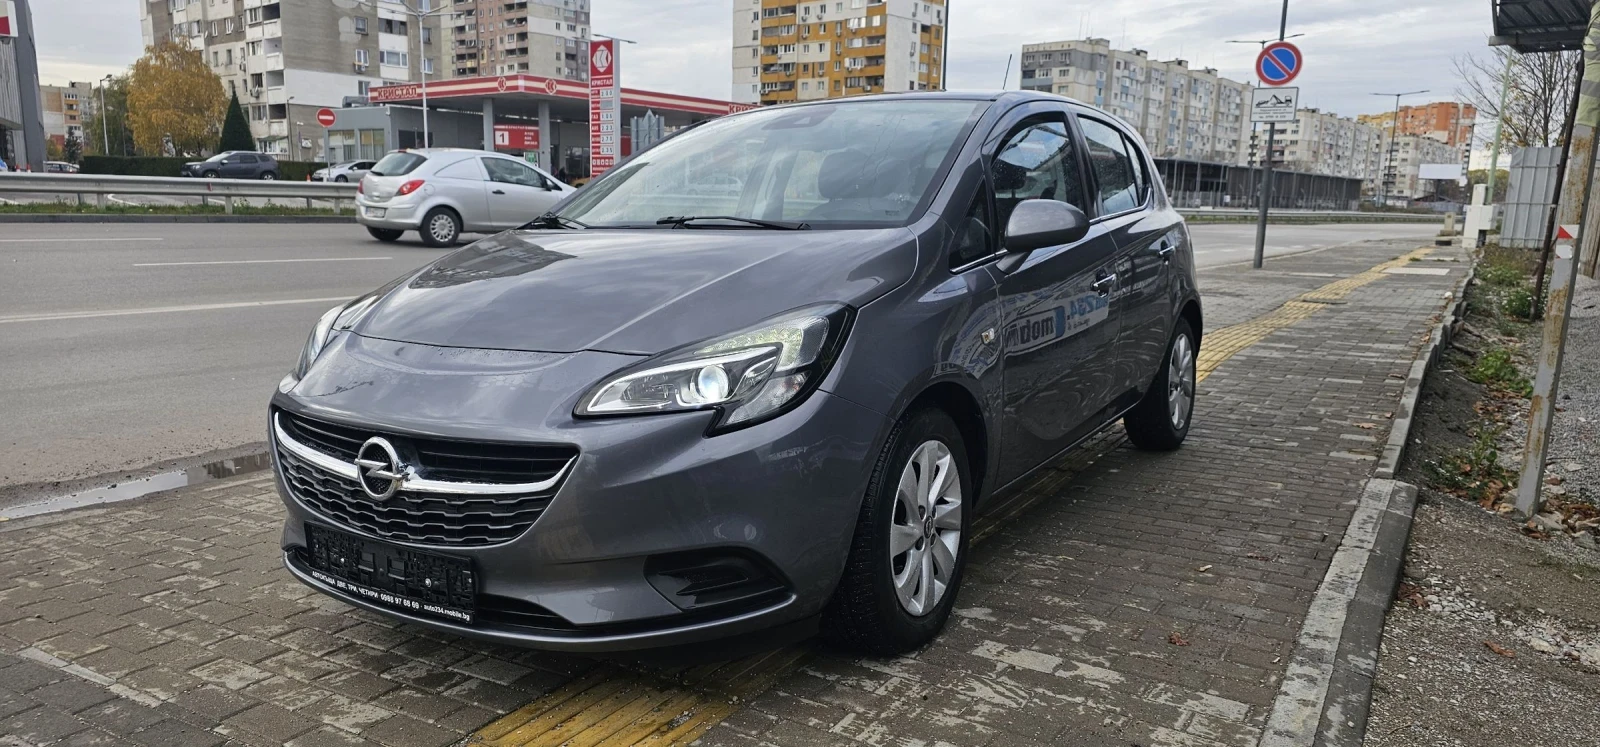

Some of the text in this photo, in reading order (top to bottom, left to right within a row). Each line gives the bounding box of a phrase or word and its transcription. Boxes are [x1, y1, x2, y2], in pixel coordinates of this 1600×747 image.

[592, 78, 612, 86] КРИСТАЛ
[377, 86, 417, 100] КРИСТАЛ
[499, 132, 505, 144] 1
[312, 570, 336, 585] АВТОКЪЩА
[348, 582, 359, 593] ТРИ,
[358, 587, 379, 599] ЧЕТИРИ
[380, 593, 394, 603] 0988
[394, 596, 402, 605] 97
[424, 604, 470, 621] auto234.mobile.bg
